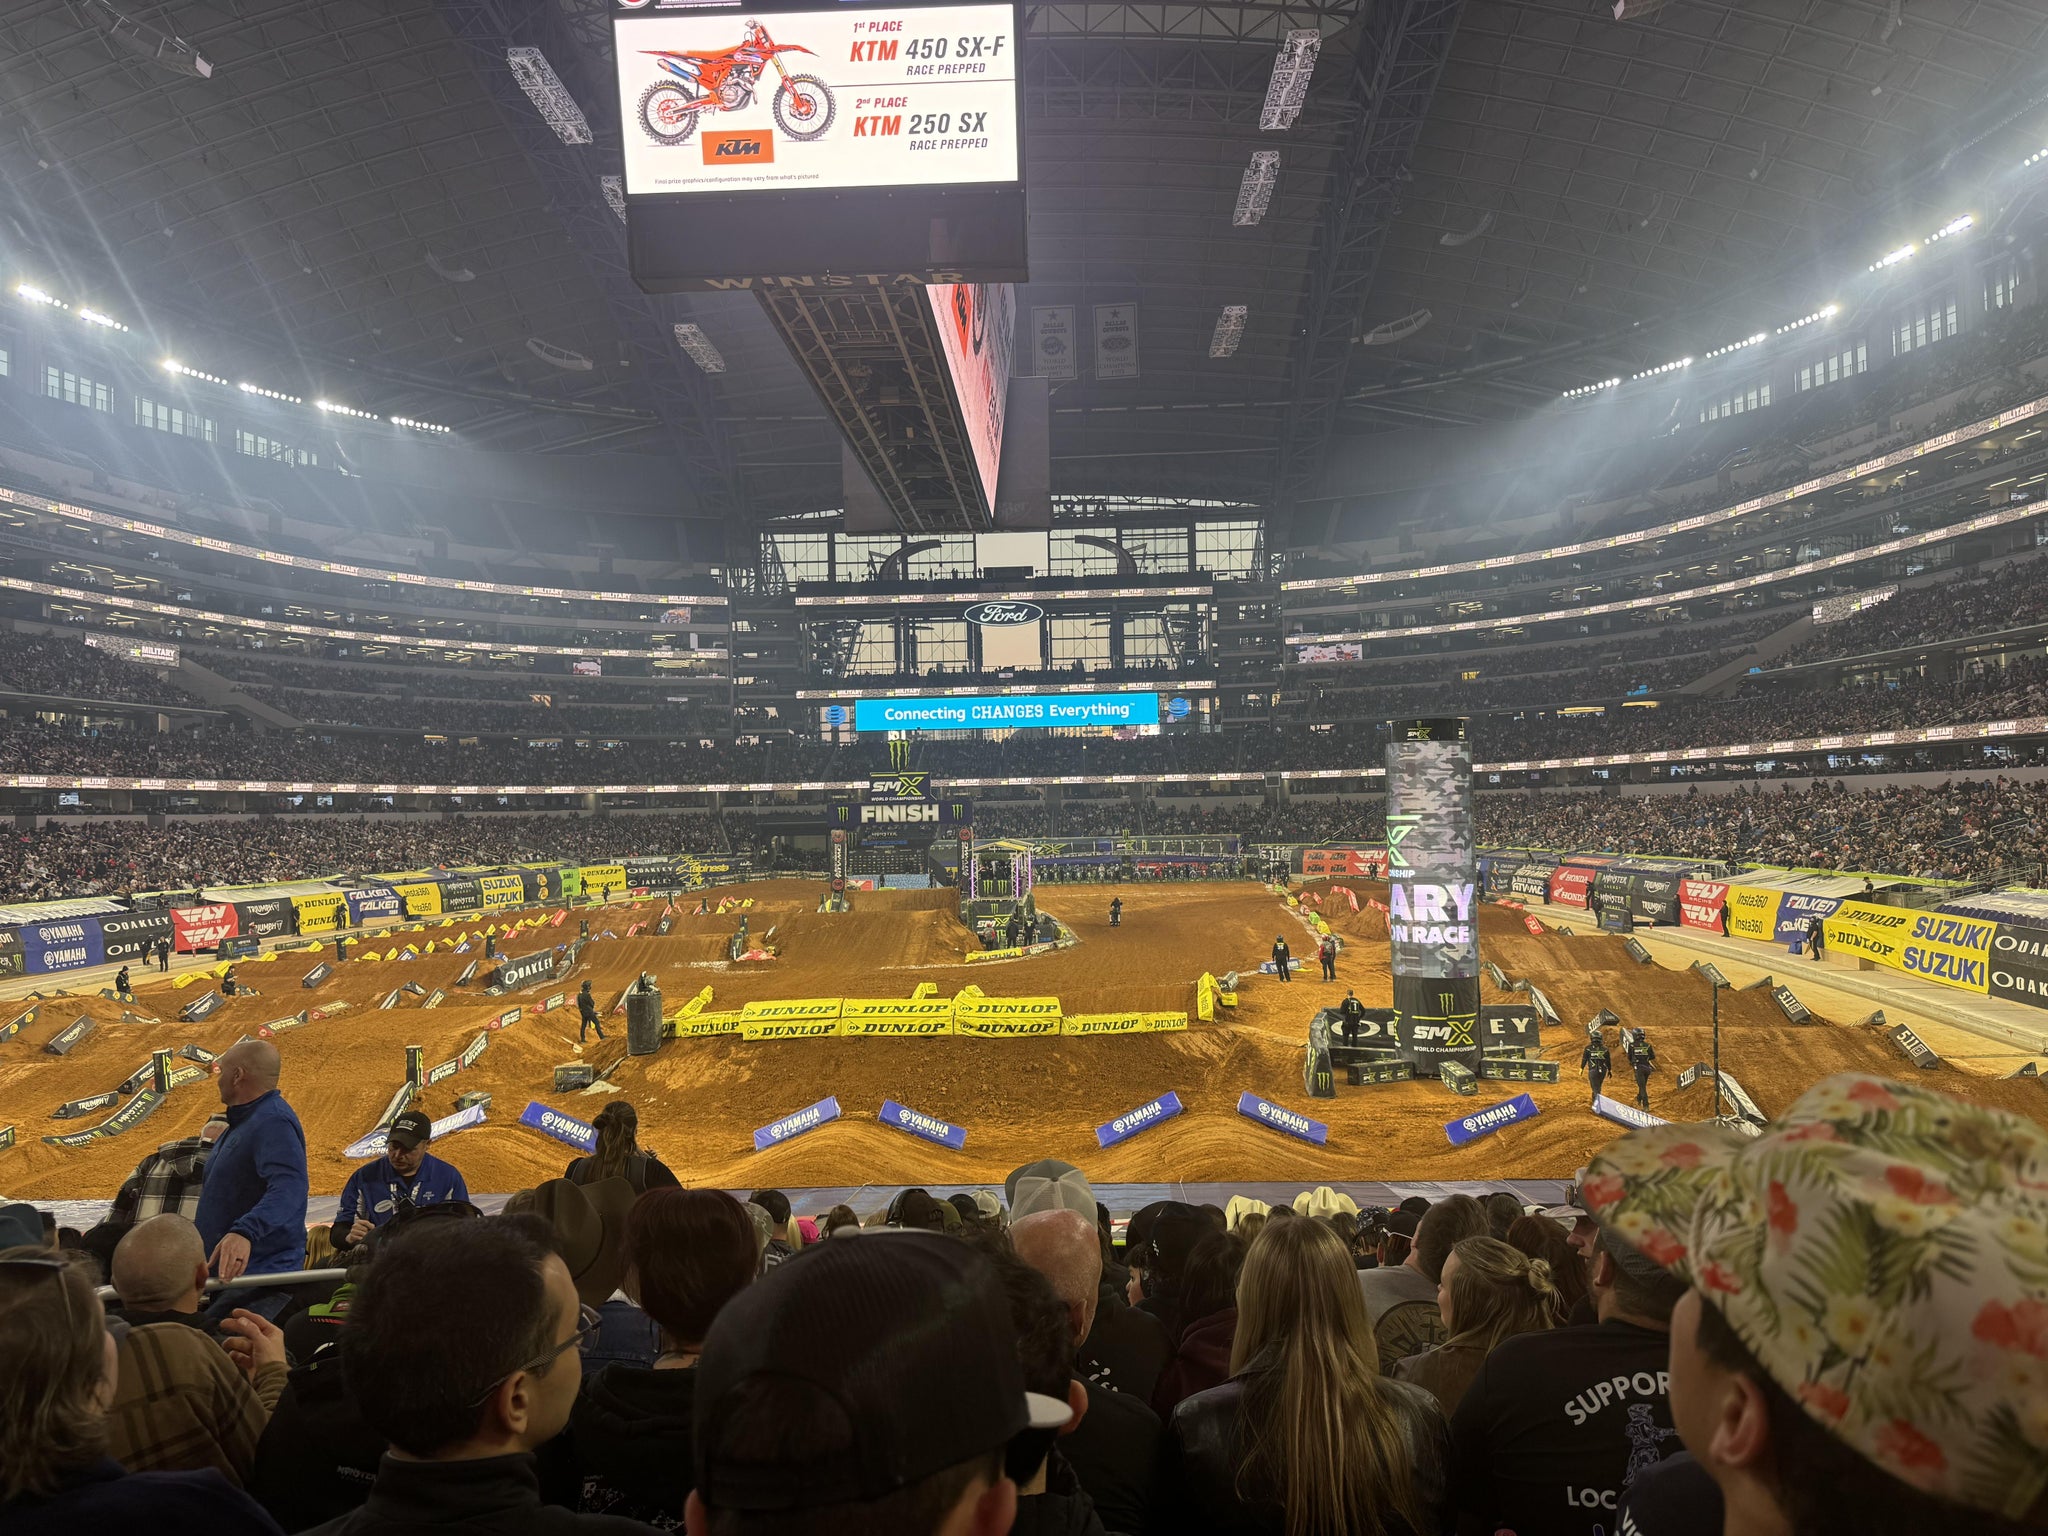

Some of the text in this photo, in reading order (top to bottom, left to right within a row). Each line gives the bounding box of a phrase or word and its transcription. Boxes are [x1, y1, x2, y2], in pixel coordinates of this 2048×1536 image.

[869, 21, 902, 32] PLACE
[850, 36, 1005, 62] KTM 450 SX-F
[906, 63, 985, 76] RACE PREPPED
[874, 97, 908, 108] PLACE
[854, 112, 987, 136] KTM 250 SX
[716, 139, 760, 156] KTM
[910, 138, 988, 150] RACE PREPPED
[2000, 402, 2035, 422] MILITARY
[1925, 431, 1957, 449] MILITARY
[1857, 457, 1886, 475] MILITARY
[1795, 480, 1820, 495] MILITARY
[59, 504, 93, 517] MILITARY
[1737, 500, 1761, 514] MILITARY
[134, 521, 165, 535] MILITARY
[1678, 516, 1705, 530] MILITARY
[201, 537, 231, 549] MILITARY
[1616, 532, 1644, 544] MILITARY
[265, 551, 294, 563] MILITARY
[1552, 545, 1580, 558] MILITARY
[331, 563, 359, 574] MILITARY
[1486, 556, 1515, 568] MILITARY
[1420, 566, 1448, 576] MILITARY
[397, 573, 426, 583] MILITARY
[1354, 574, 1382, 583] MILITARY
[465, 581, 494, 590] MILITARY
[533, 588, 563, 596] MILITARY
[602, 592, 631, 600] MILITARY
[980, 604, 1028, 622] Ford
[142, 646, 175, 656] MILITARY
[885, 706, 966, 722] Connecting
[972, 704, 1043, 720] CHANGES
[1988, 721, 2017, 732] MILITARY
[861, 804, 939, 823] FINISH
[483, 876, 522, 889] SUZUKI
[1566, 874, 1588, 882] HONDA
[1602, 874, 1627, 884] MONSTER
[349, 889, 391, 900] FALKEN
[404, 888, 430, 897] Insta360
[1689, 882, 1725, 898] FLY
[305, 897, 341, 908] DUNLOP
[485, 892, 523, 904] SUZUKI
[1600, 894, 1624, 904] MONSTER
[1737, 892, 1768, 908] Insta360
[1786, 895, 1837, 912] FALKEN
[247, 904, 273, 912] TRIUMPH
[360, 900, 398, 911] FALKEN
[186, 905, 226, 922] FLY
[1685, 904, 1720, 922] FLY
[1847, 910, 1906, 928] DUNLOP
[122, 917, 169, 929] OAKLEY
[307, 916, 337, 926] DUNLO
[1736, 916, 1762, 934] Insta360
[49, 925, 84, 939] YAMAHA
[191, 925, 231, 942] FLY
[1412, 926, 1469, 944] RACE
[1912, 916, 1992, 950] SUZUKI
[1837, 932, 1894, 956] DUNLOP
[54, 948, 86, 963] YAMAHA
[49, 961, 85, 969] RACING
[519, 957, 552, 978] OAKLEY
[1903, 947, 1984, 986] SUZUKI
[757, 1005, 836, 1016] DUNLOP
[862, 1004, 948, 1014] DUNLOP
[976, 1004, 1058, 1012] DUNLOP
[691, 1022, 739, 1033] DUNLOP
[862, 1022, 946, 1032] DUNLOP
[978, 1022, 1053, 1033] DUNLOP
[1080, 1019, 1138, 1032] DUNLOP
[1154, 1018, 1186, 1028] DUNLOP
[761, 1024, 836, 1036] DUNLOP
[1413, 1020, 1475, 1046] SMX
[78, 1098, 105, 1111] TRIUMPH
[118, 1100, 145, 1123] MONSTER
[1122, 1102, 1162, 1128] YAMAHA
[1474, 1103, 1518, 1130] YAMAHA
[782, 1106, 820, 1131] YAMAHA
[910, 1112, 949, 1137] YAMAHA
[1269, 1106, 1310, 1132] YAMAHA
[552, 1116, 592, 1140] YAMAHA
